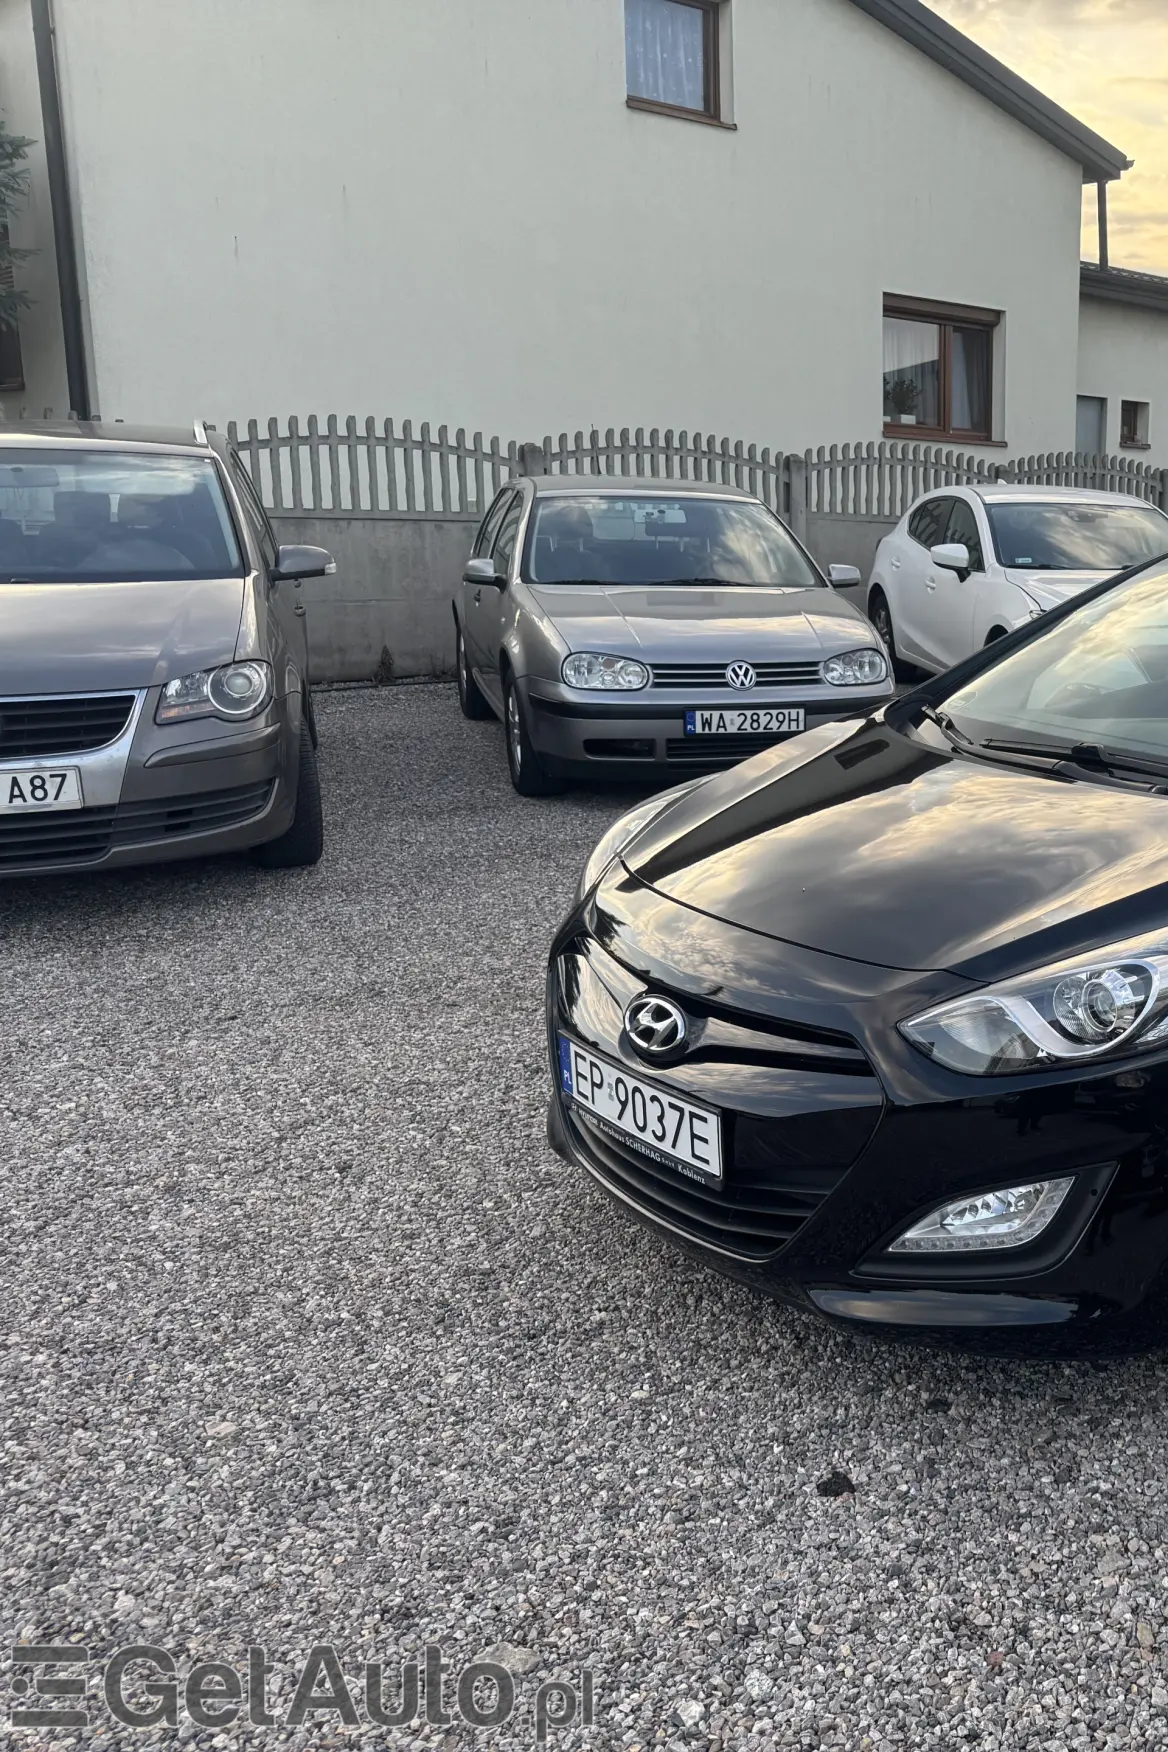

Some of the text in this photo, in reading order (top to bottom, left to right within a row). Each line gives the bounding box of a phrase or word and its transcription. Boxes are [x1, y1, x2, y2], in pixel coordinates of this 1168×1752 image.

[700, 711, 800, 732] WA 2829H
[8, 773, 67, 804] A87
[563, 1069, 572, 1085] PL
[574, 1050, 710, 1166] EP 9037E
[600, 1121, 625, 1143] Autohaus
[625, 1136, 661, 1162] SCHERHAG
[677, 1163, 706, 1184] Koblenz
